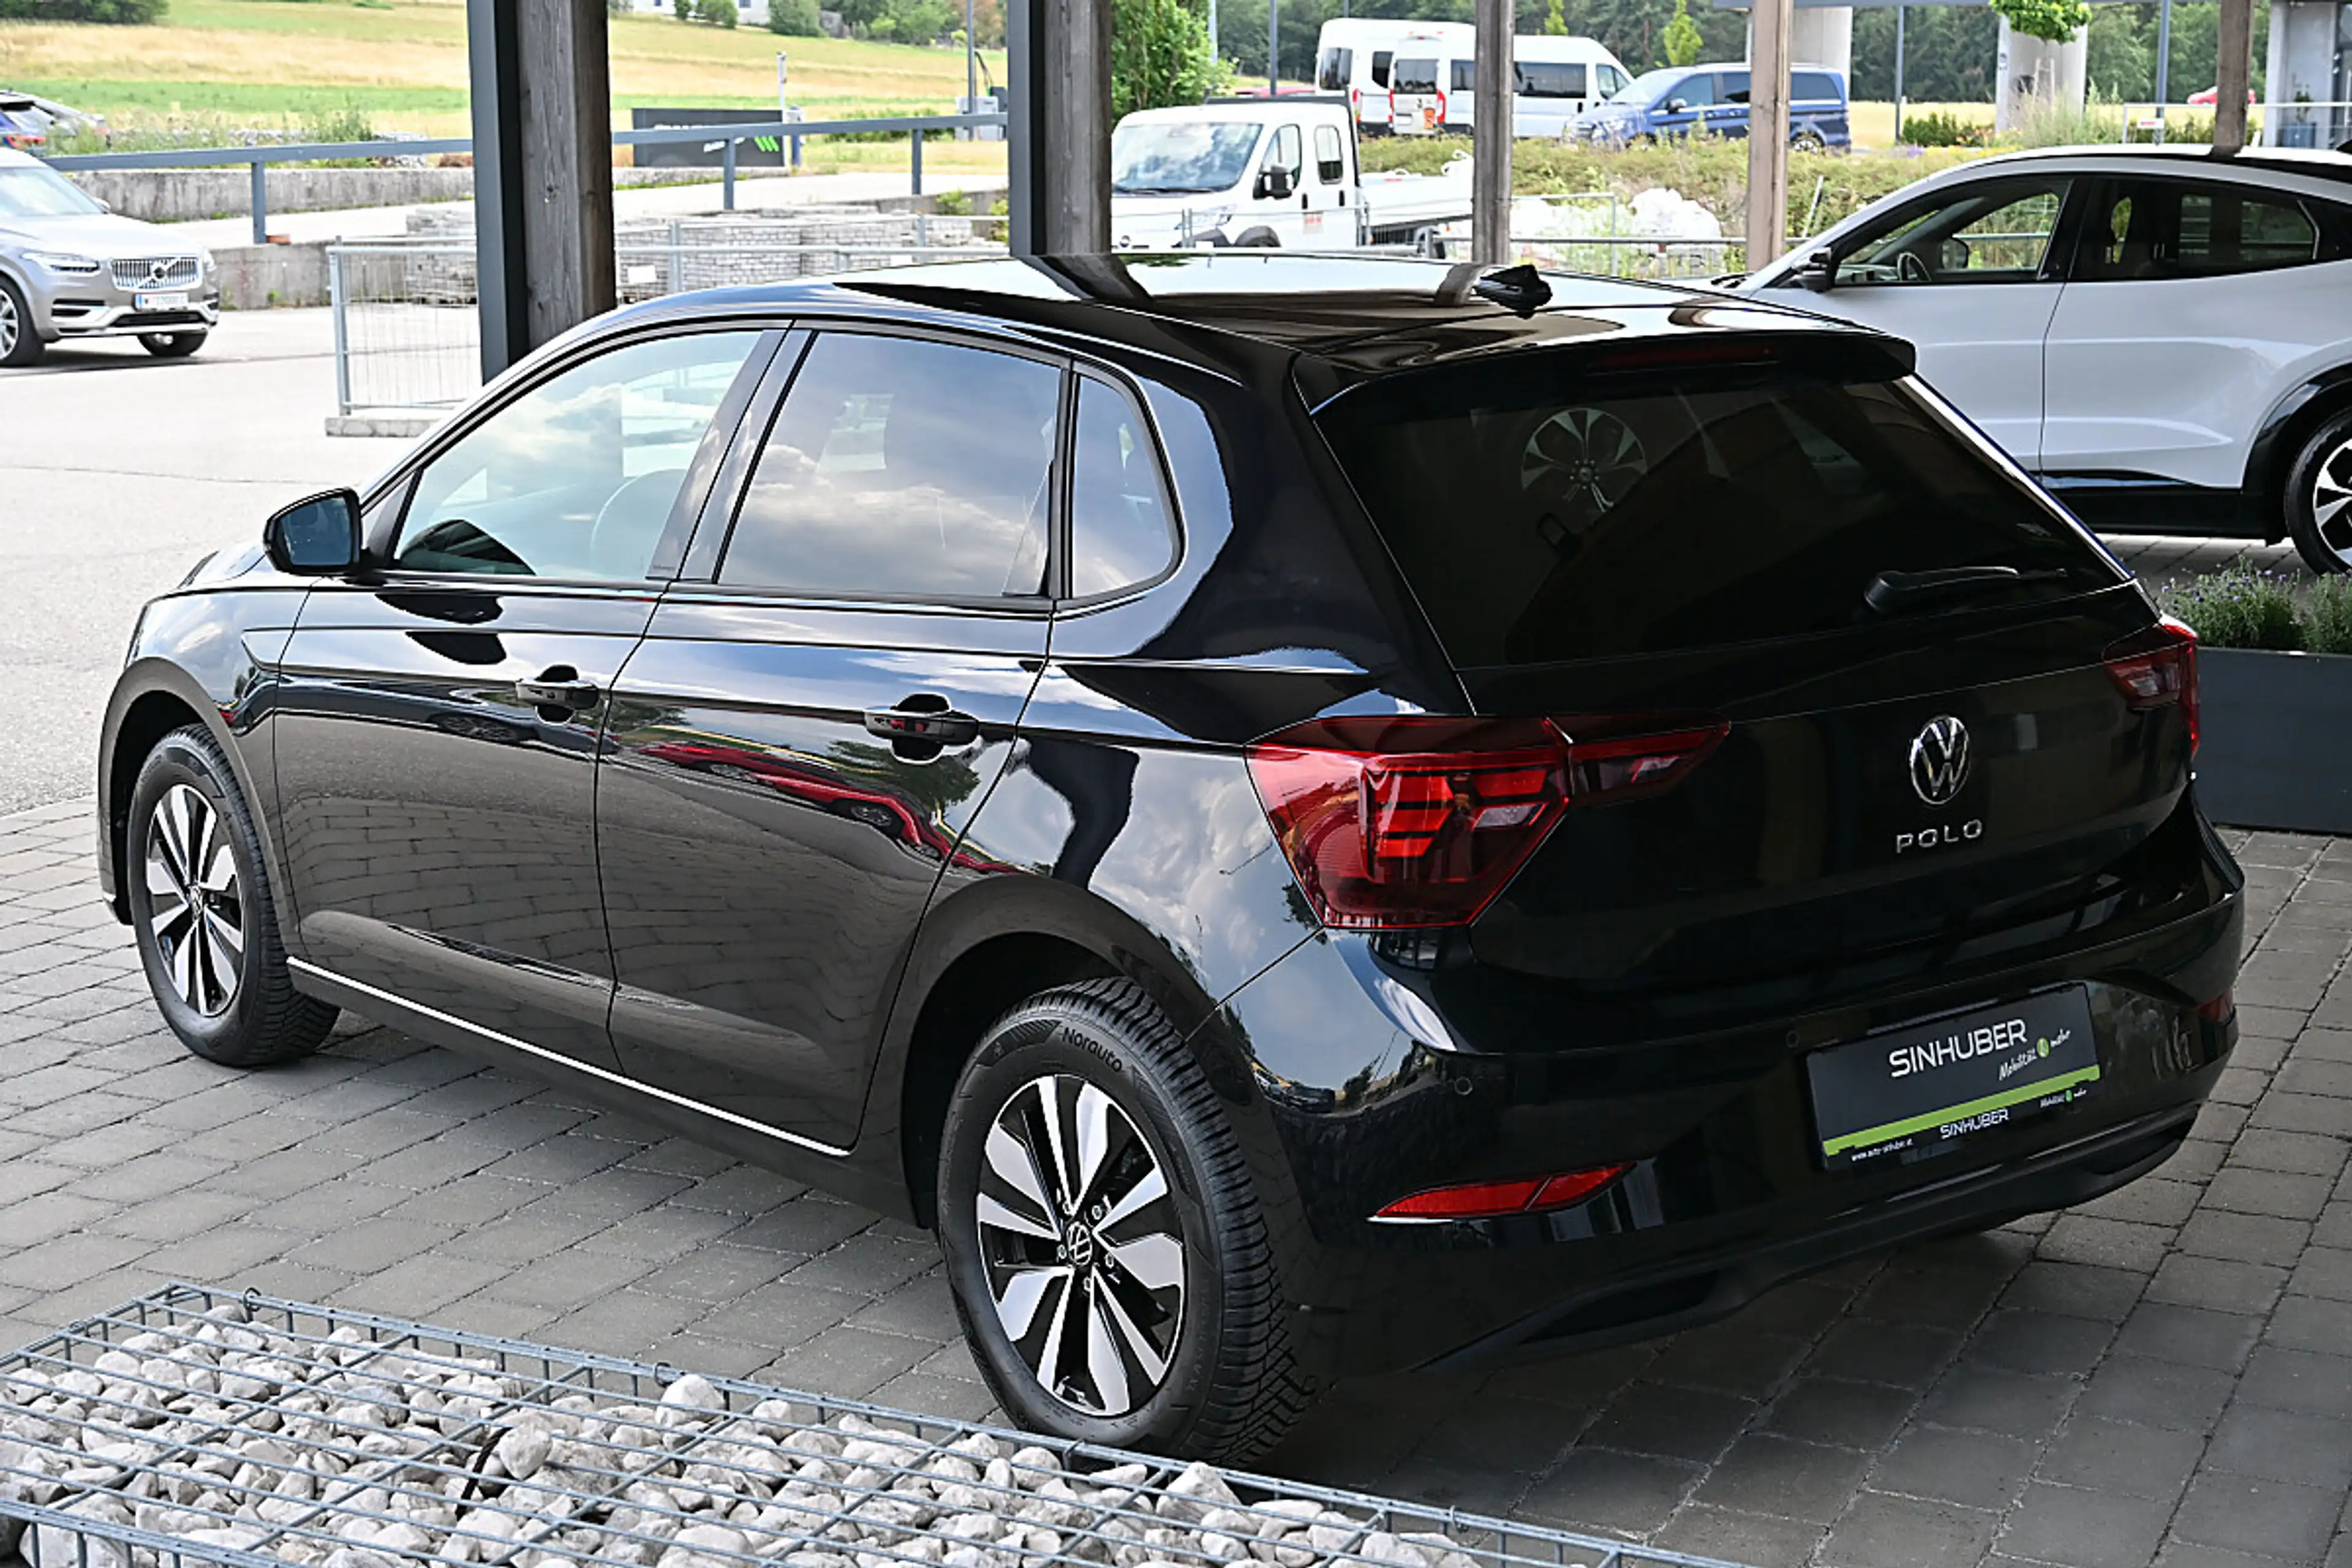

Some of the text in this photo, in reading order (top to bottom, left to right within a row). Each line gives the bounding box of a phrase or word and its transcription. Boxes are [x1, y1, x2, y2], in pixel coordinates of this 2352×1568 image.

[1897, 819, 1982, 853] POLO
[1063, 1027, 1122, 1072] Norauto
[1889, 1019, 2027, 1077] SINHUBER
[1940, 1107, 2009, 1139] SINHUBER
